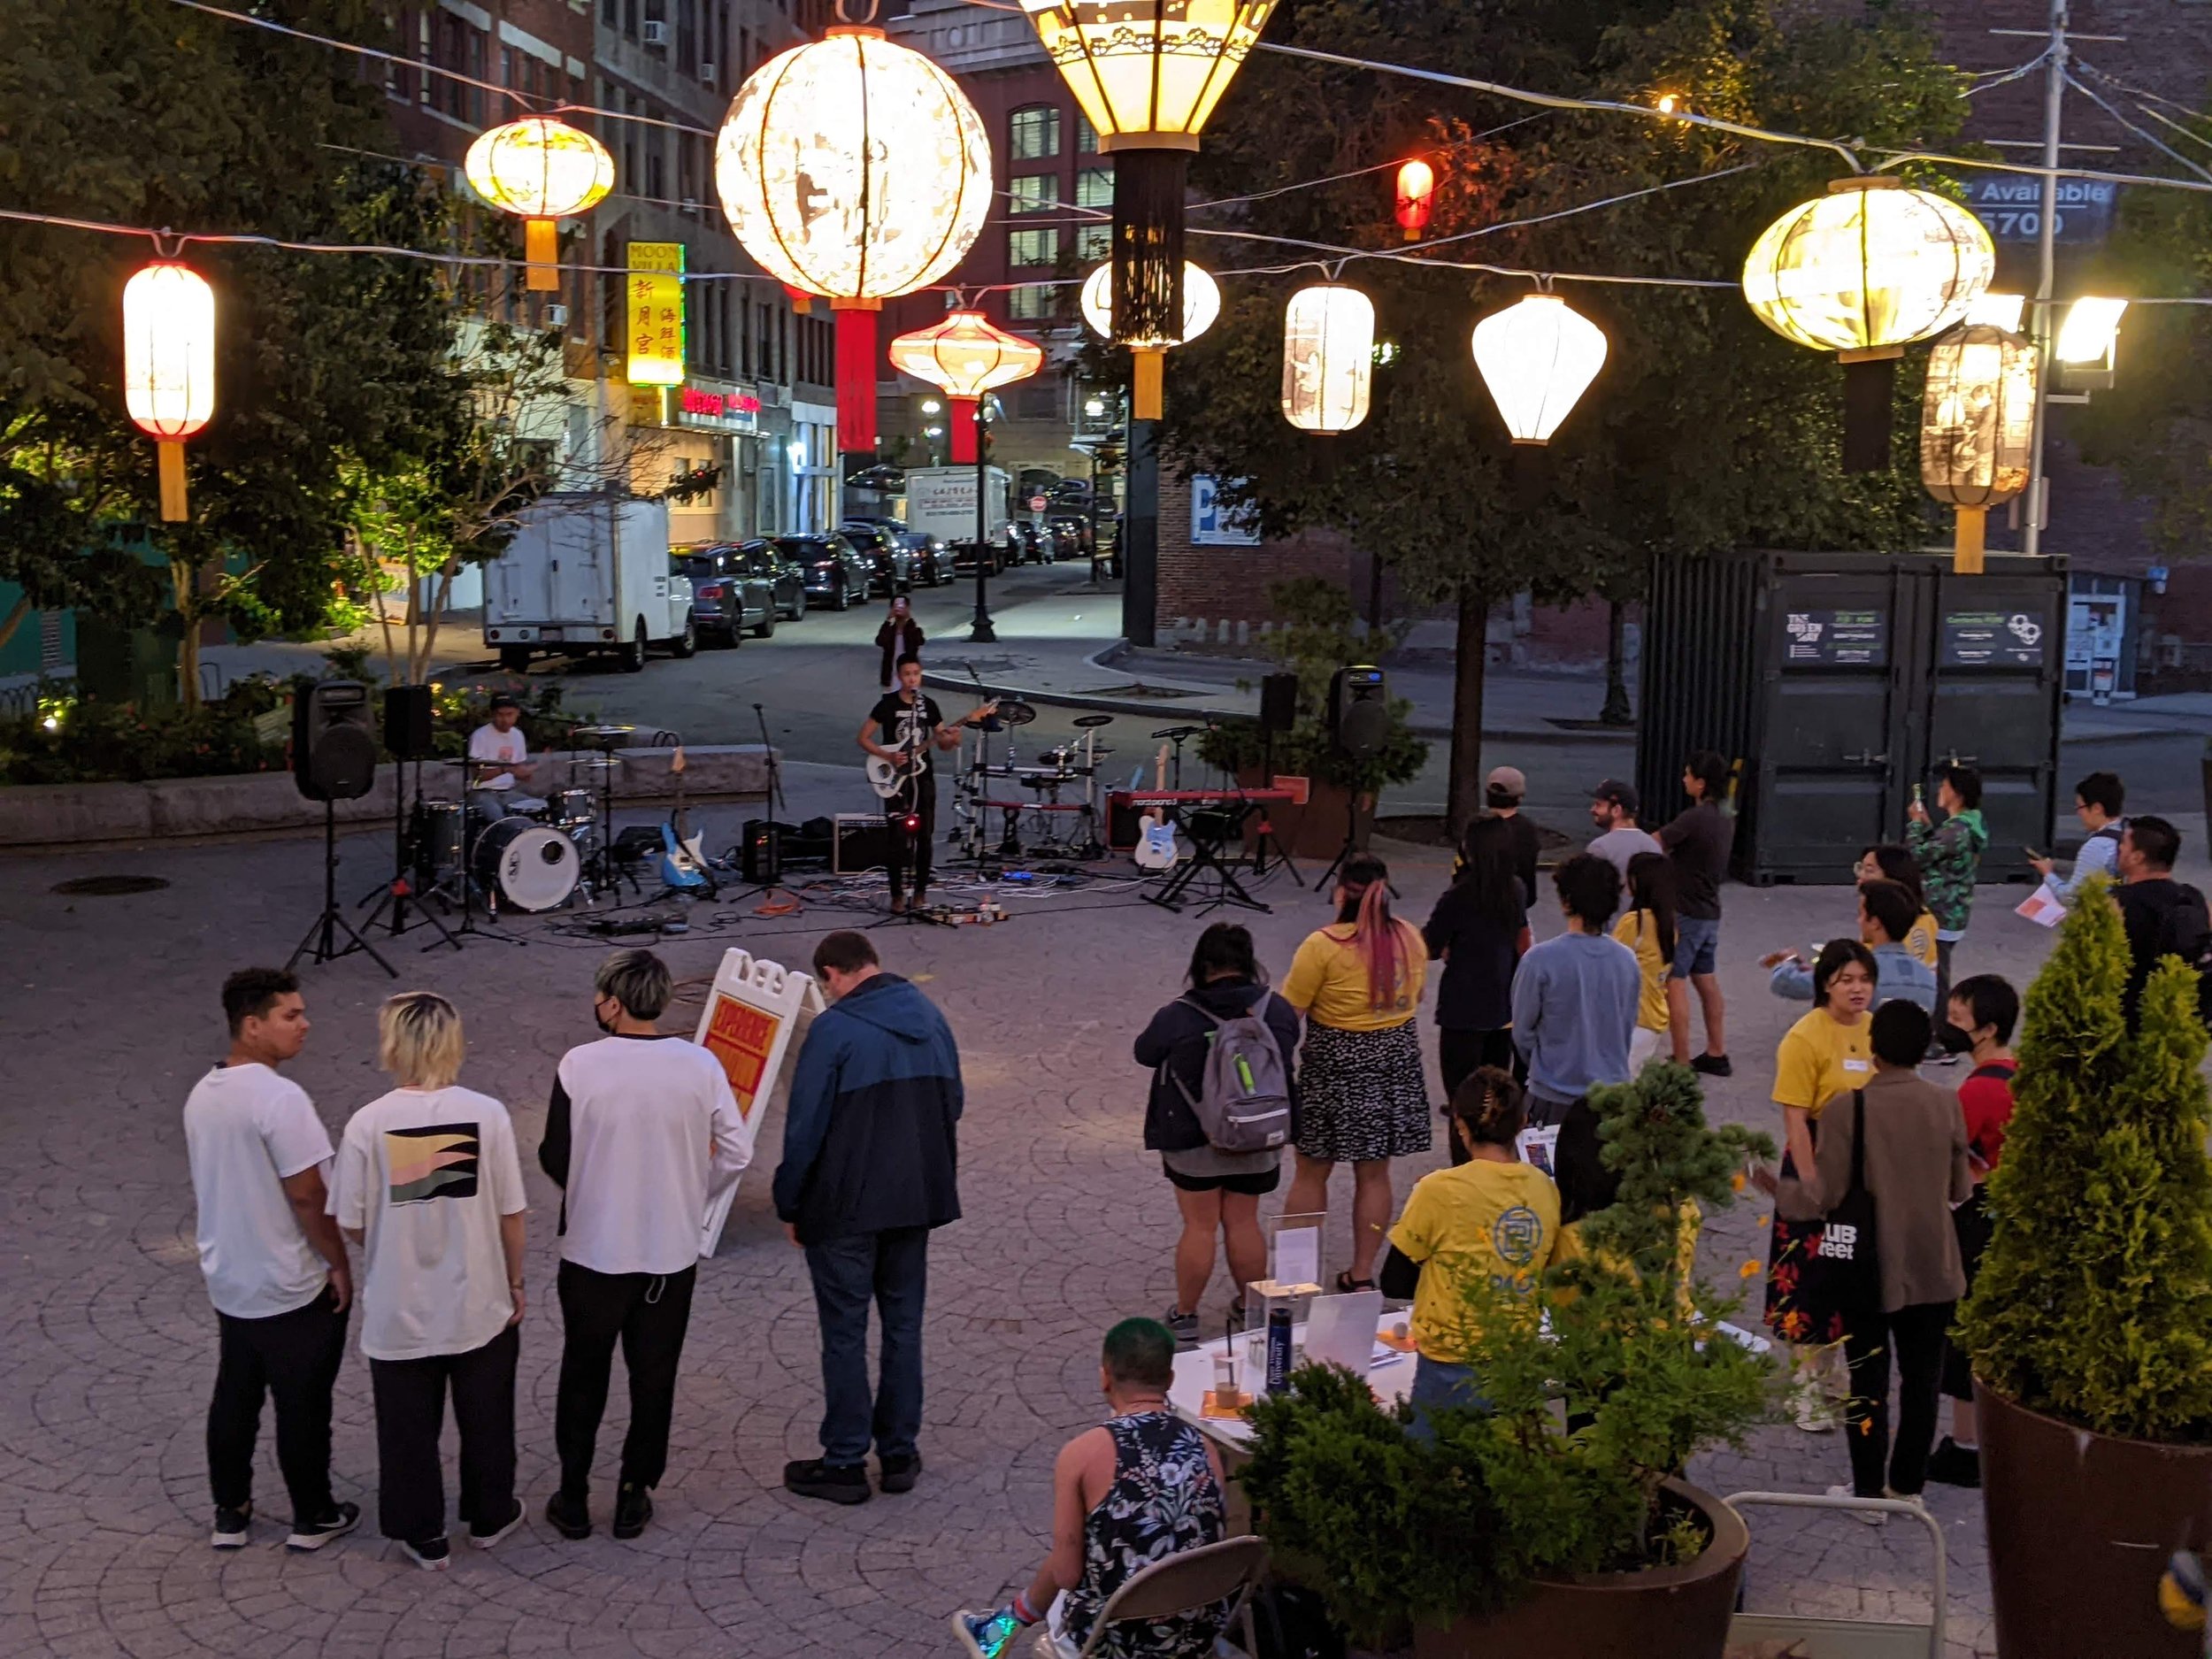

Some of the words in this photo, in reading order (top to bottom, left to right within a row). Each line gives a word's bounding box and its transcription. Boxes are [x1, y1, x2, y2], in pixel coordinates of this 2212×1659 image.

[1981, 182, 2111, 202] Avaiable
[631, 245, 678, 257] MOON
[1821, 1223, 1857, 1244] UB
